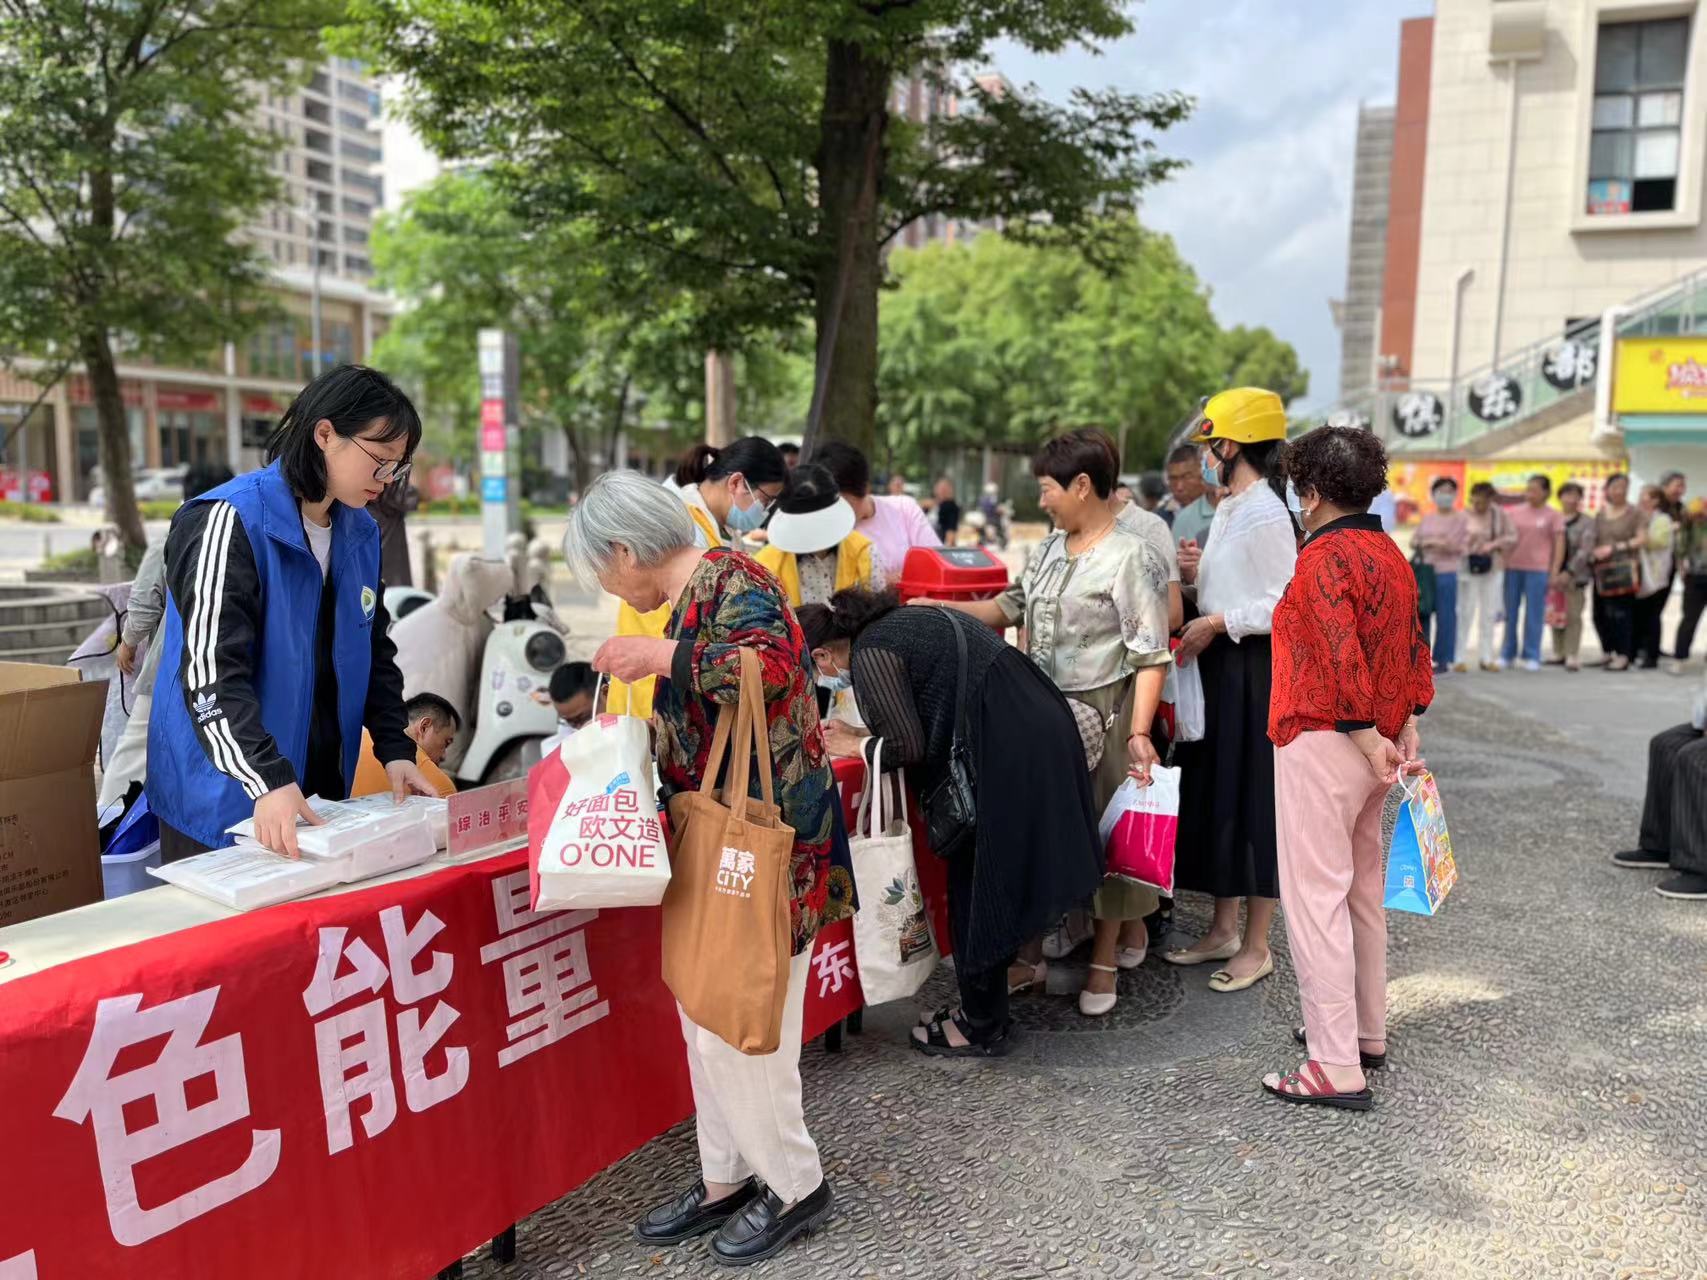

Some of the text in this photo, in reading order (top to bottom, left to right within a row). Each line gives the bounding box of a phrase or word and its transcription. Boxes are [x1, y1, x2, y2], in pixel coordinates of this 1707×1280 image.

[197, 707, 223, 723] adidas
[458, 800, 528, 833] 综治平安
[561, 788, 639, 819] 好面包
[579, 816, 661, 843] 欧文造
[559, 843, 655, 868] O'ONE
[811, 938, 855, 998] 东
[0, 870, 610, 1280] 色能量
